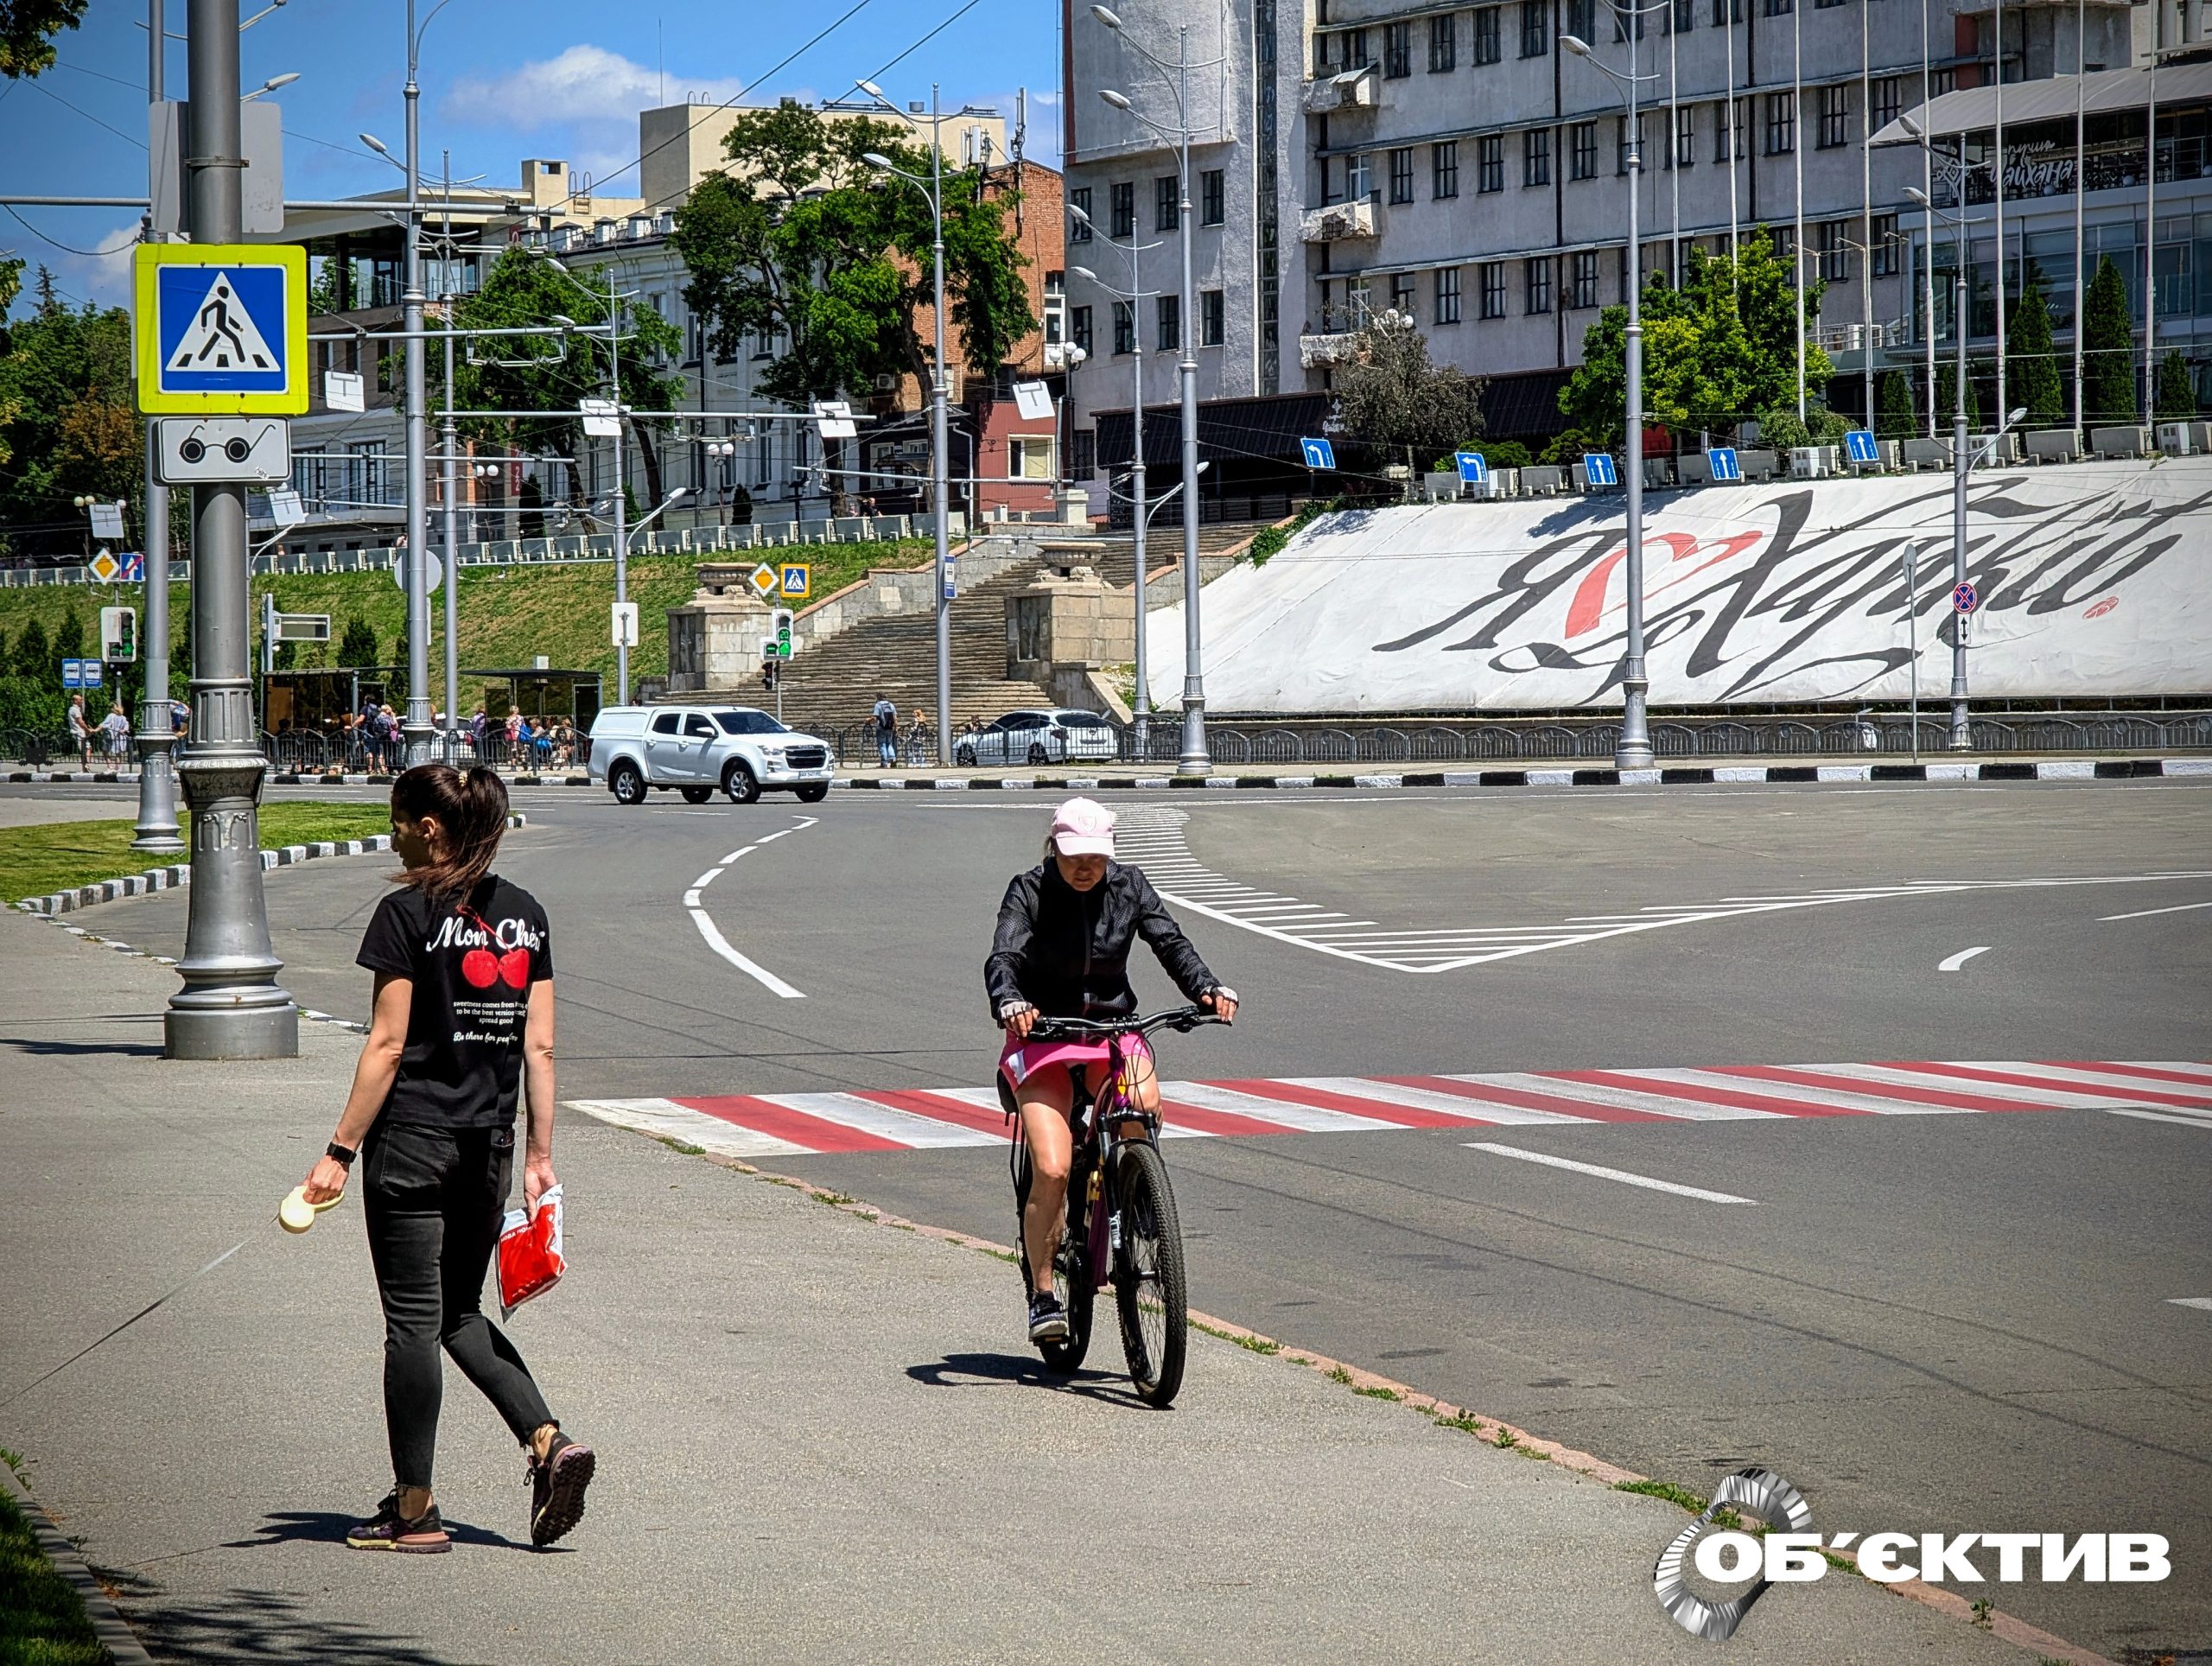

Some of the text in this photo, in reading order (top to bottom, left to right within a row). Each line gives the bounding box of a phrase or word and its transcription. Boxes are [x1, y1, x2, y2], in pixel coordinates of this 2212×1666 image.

[425, 916, 489, 952] Mon
[499, 1017, 514, 1026] good
[453, 1031, 465, 1042] Be
[465, 1030, 484, 1040] there
[484, 1032, 496, 1043] for
